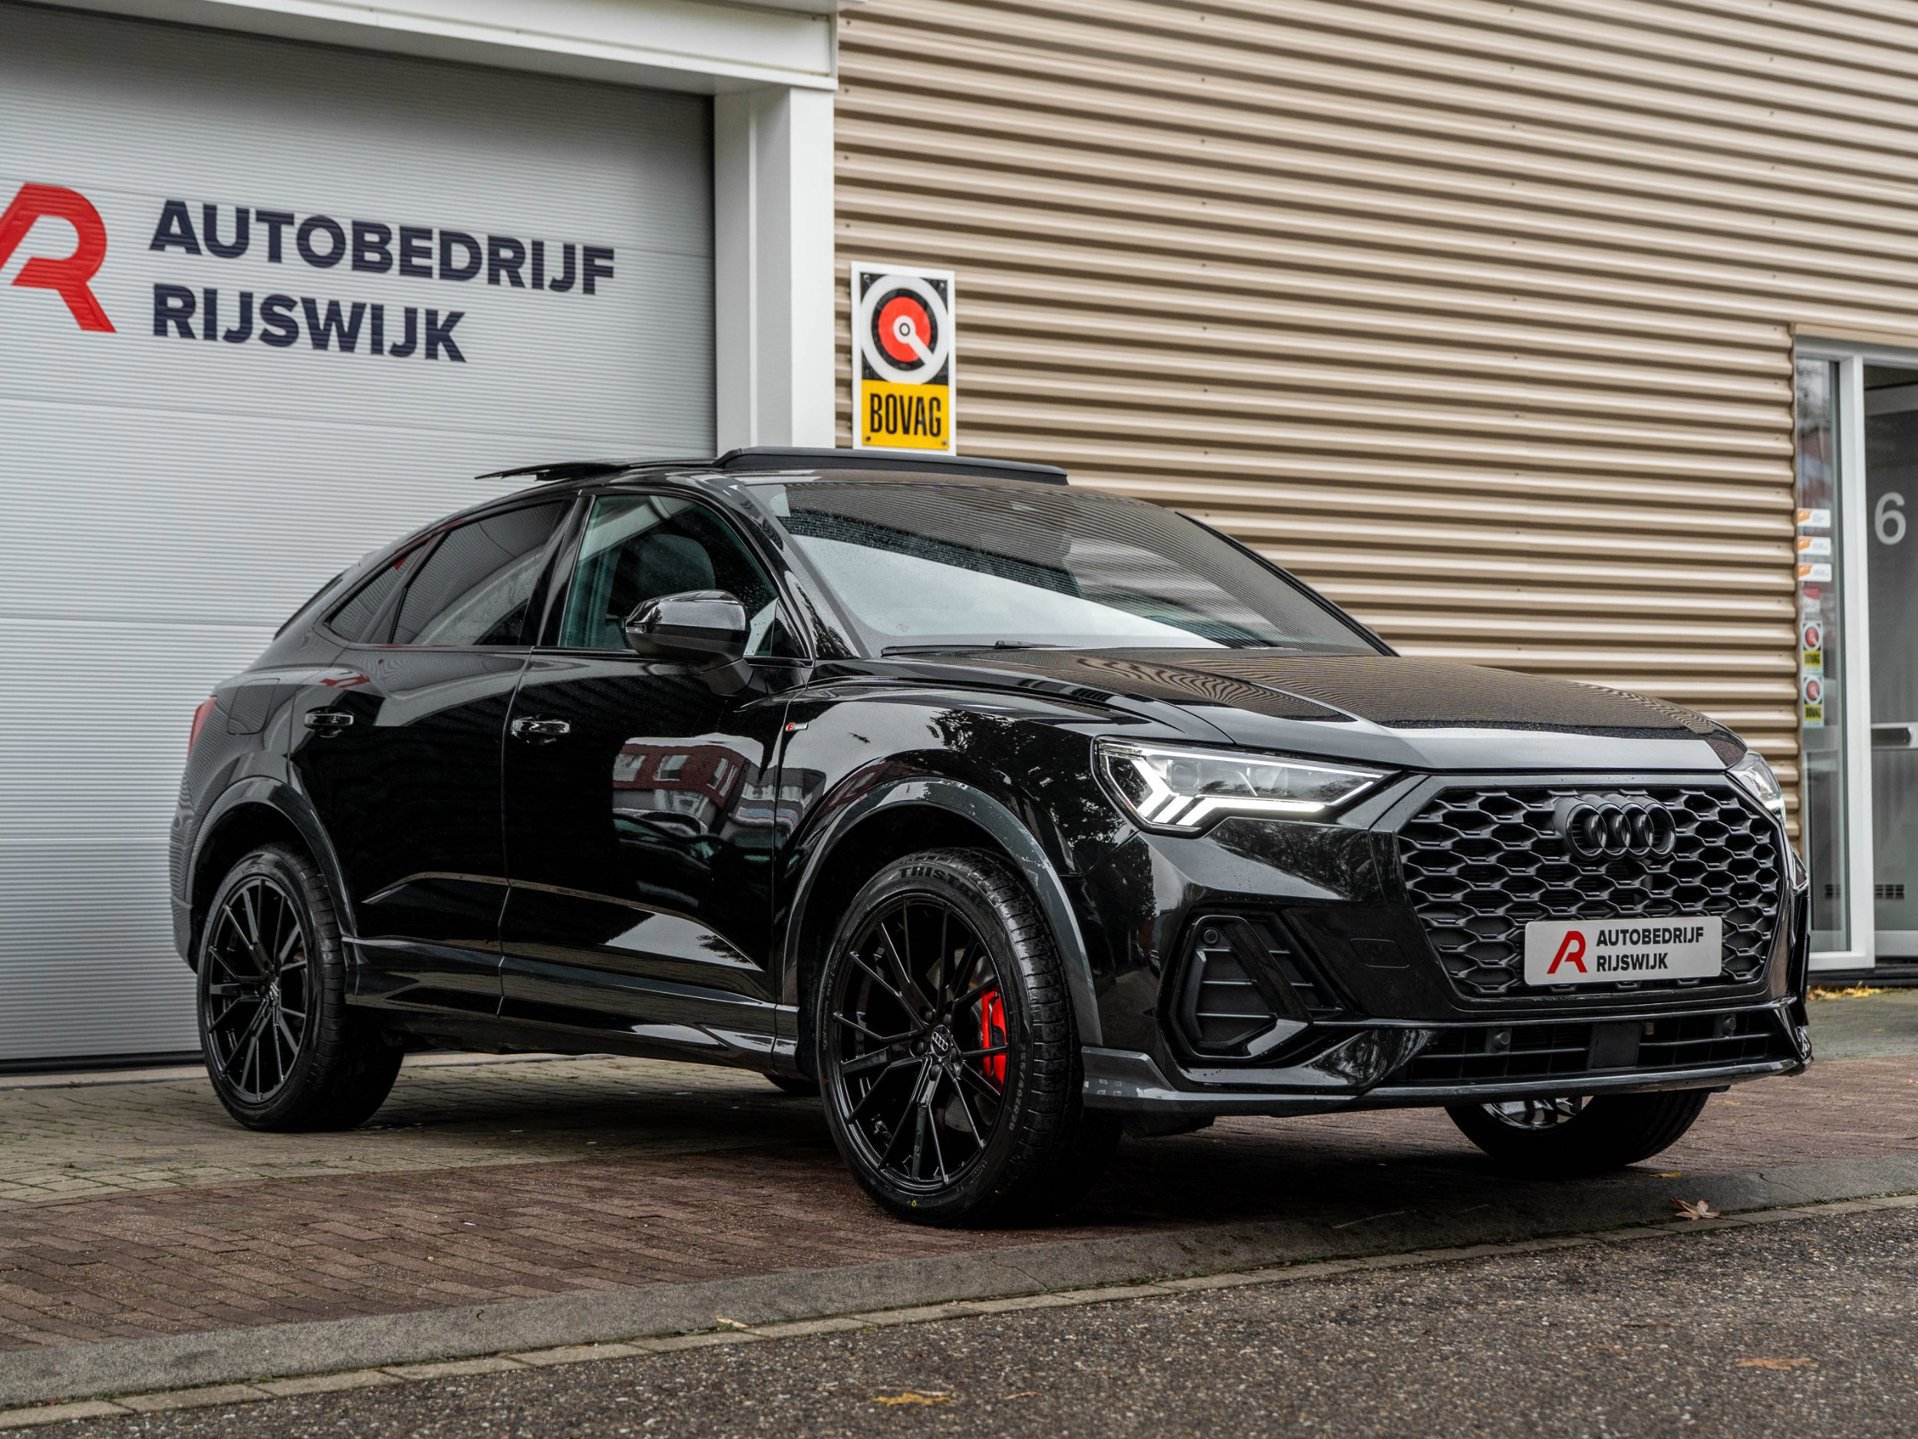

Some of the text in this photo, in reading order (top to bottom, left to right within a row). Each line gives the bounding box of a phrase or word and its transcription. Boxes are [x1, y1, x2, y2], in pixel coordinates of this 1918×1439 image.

[149, 199, 615, 295] AUTOBEDRIJF
[153, 283, 467, 363] RIJSWIJK
[870, 393, 941, 437] BOVAG
[1874, 492, 1907, 546] 6
[1596, 927, 1704, 947] AUTOBEDRIJF
[1596, 952, 1668, 972] RIJSWIJK
